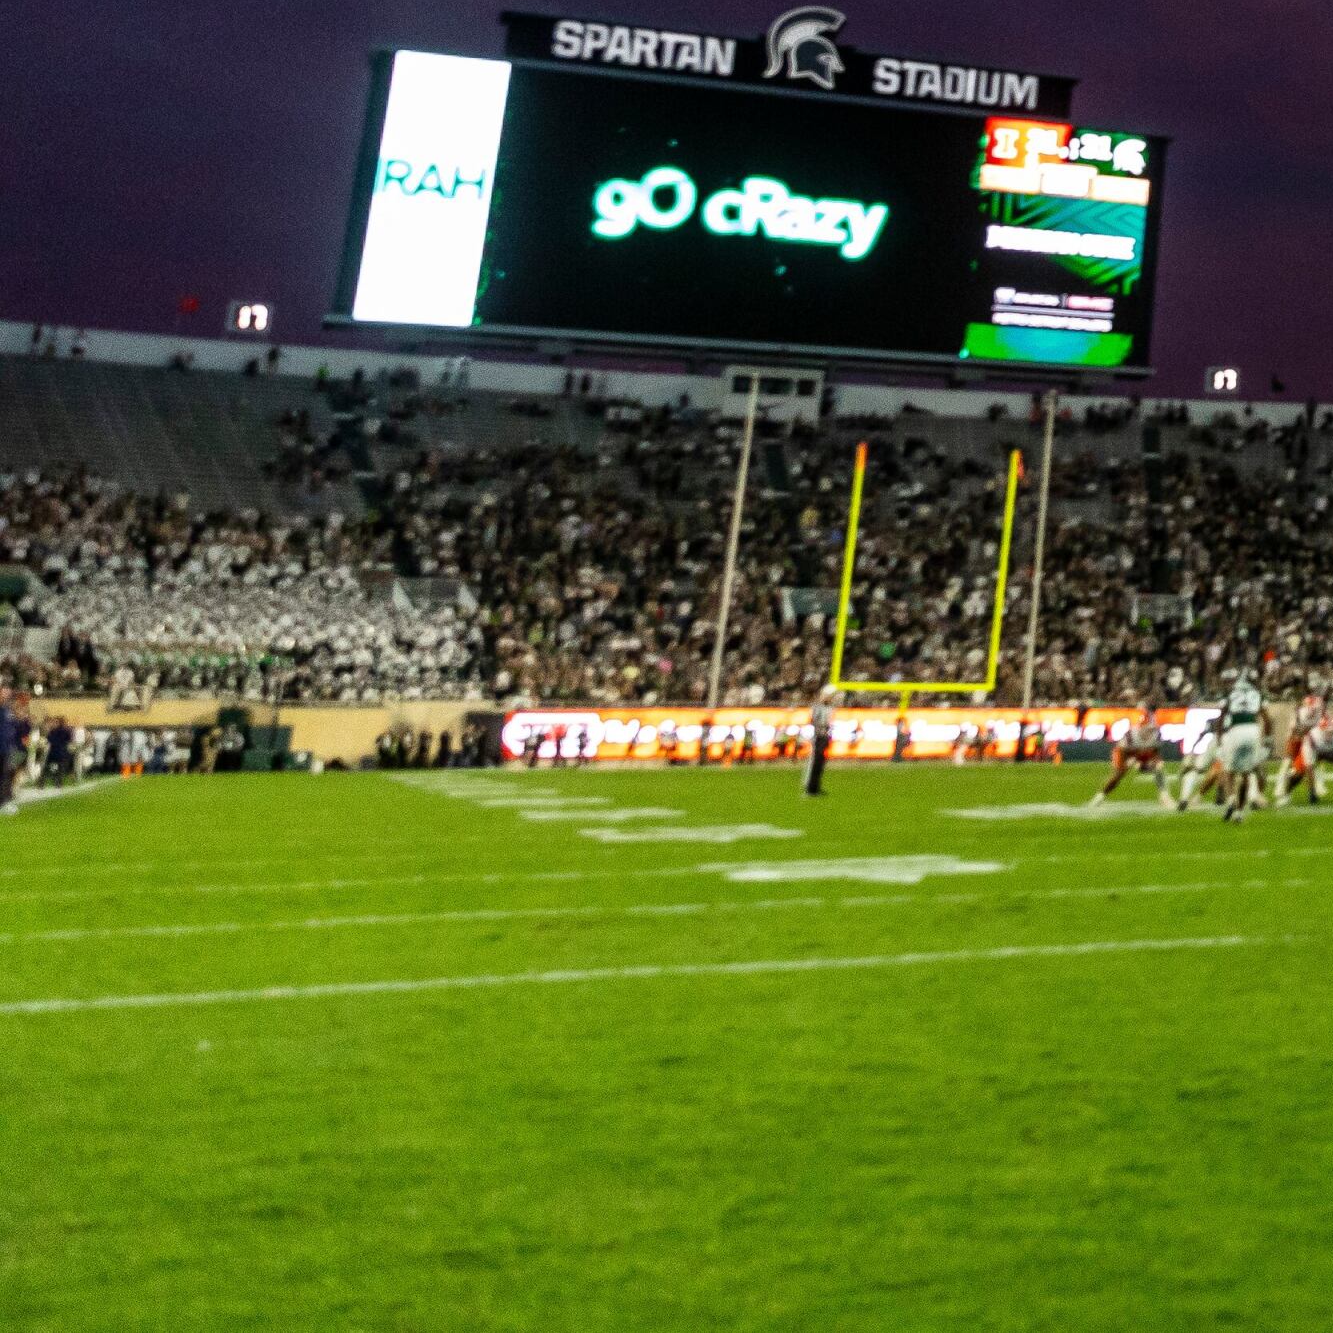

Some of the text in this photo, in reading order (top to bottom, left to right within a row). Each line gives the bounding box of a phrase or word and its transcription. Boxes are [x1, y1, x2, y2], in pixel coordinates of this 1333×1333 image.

[552, 20, 1040, 111] SPARTAN STADIUM
[701, 175, 889, 259] cRazy
